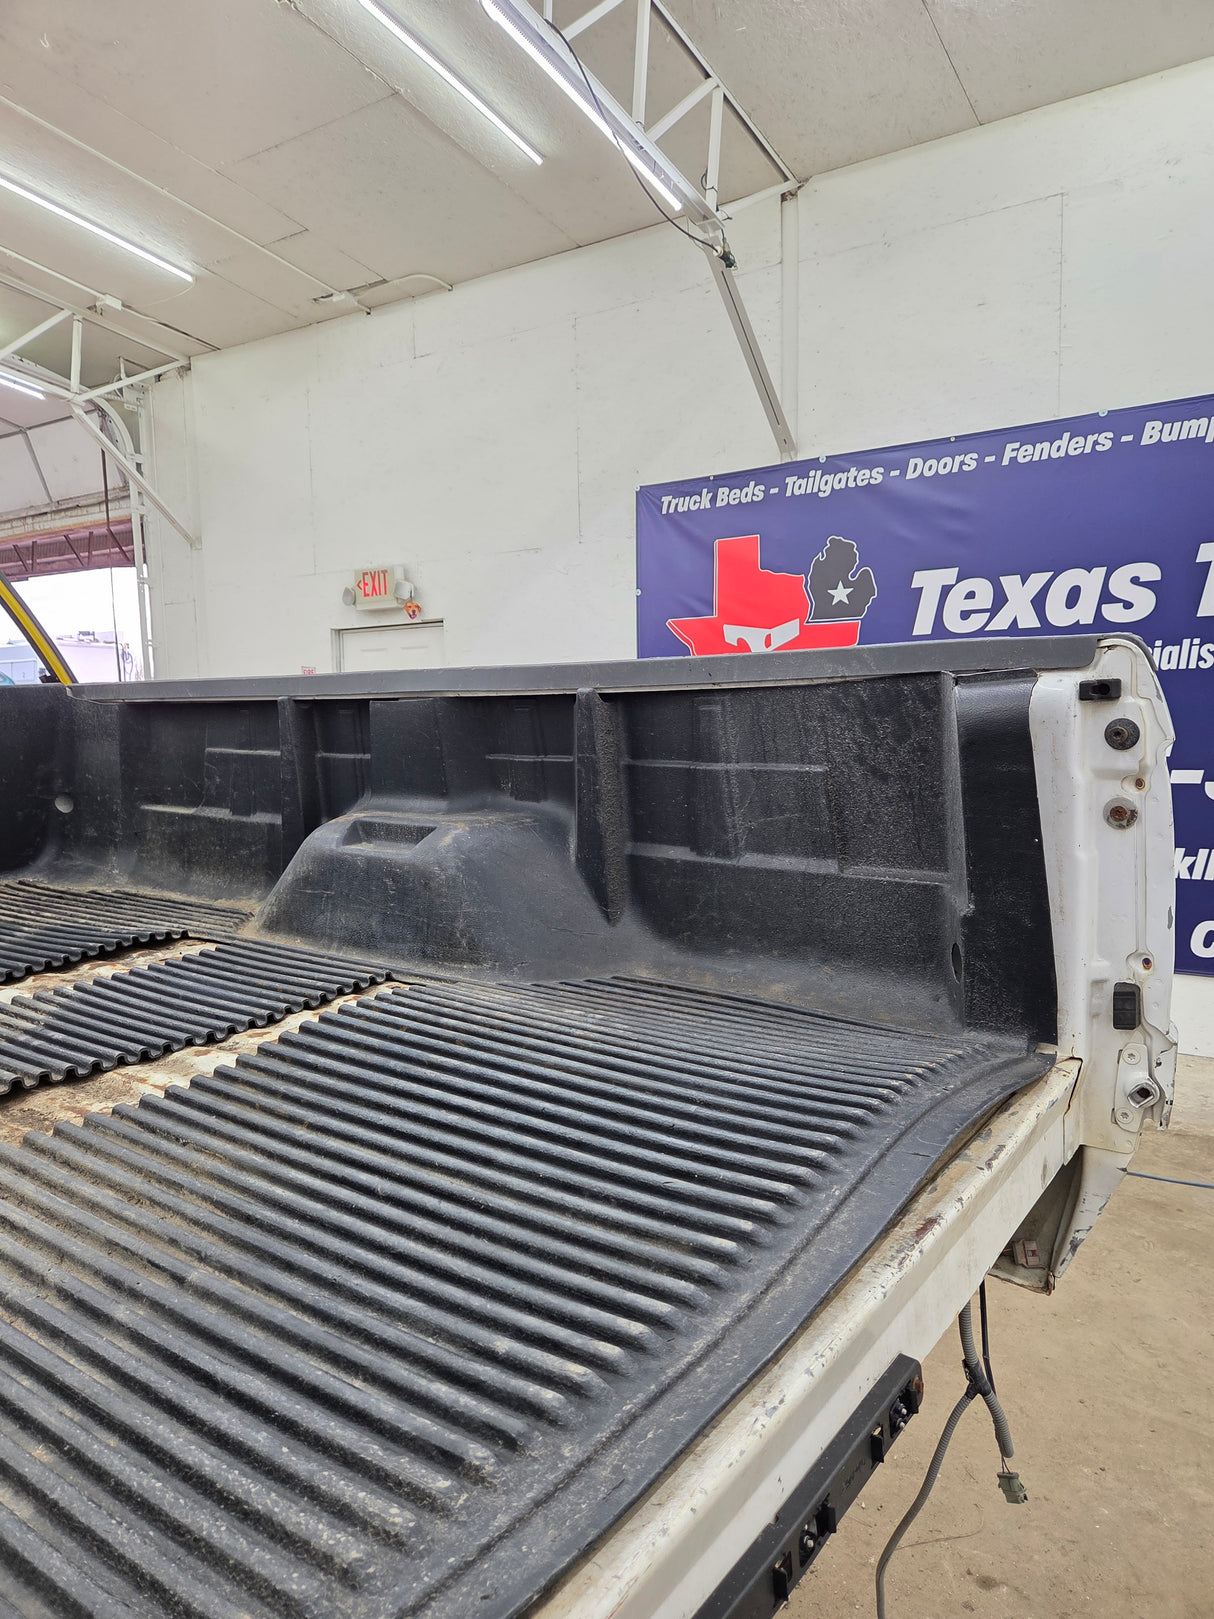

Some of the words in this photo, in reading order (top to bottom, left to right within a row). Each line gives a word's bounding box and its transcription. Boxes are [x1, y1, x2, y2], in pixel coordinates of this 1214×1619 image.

[661, 488, 713, 515] Truck
[716, 481, 765, 507] Beds
[769, 486, 779, 495] -
[785, 466, 885, 498] Tailgates
[889, 468, 900, 477] -
[905, 451, 979, 480] Doors
[984, 454, 996, 463] -
[1001, 431, 1114, 466] Fenders
[1120, 434, 1134, 442] -
[362, 569, 388, 597] EXIT
[910, 561, 1162, 636] Texas
[1148, 637, 1214, 671] ialis
